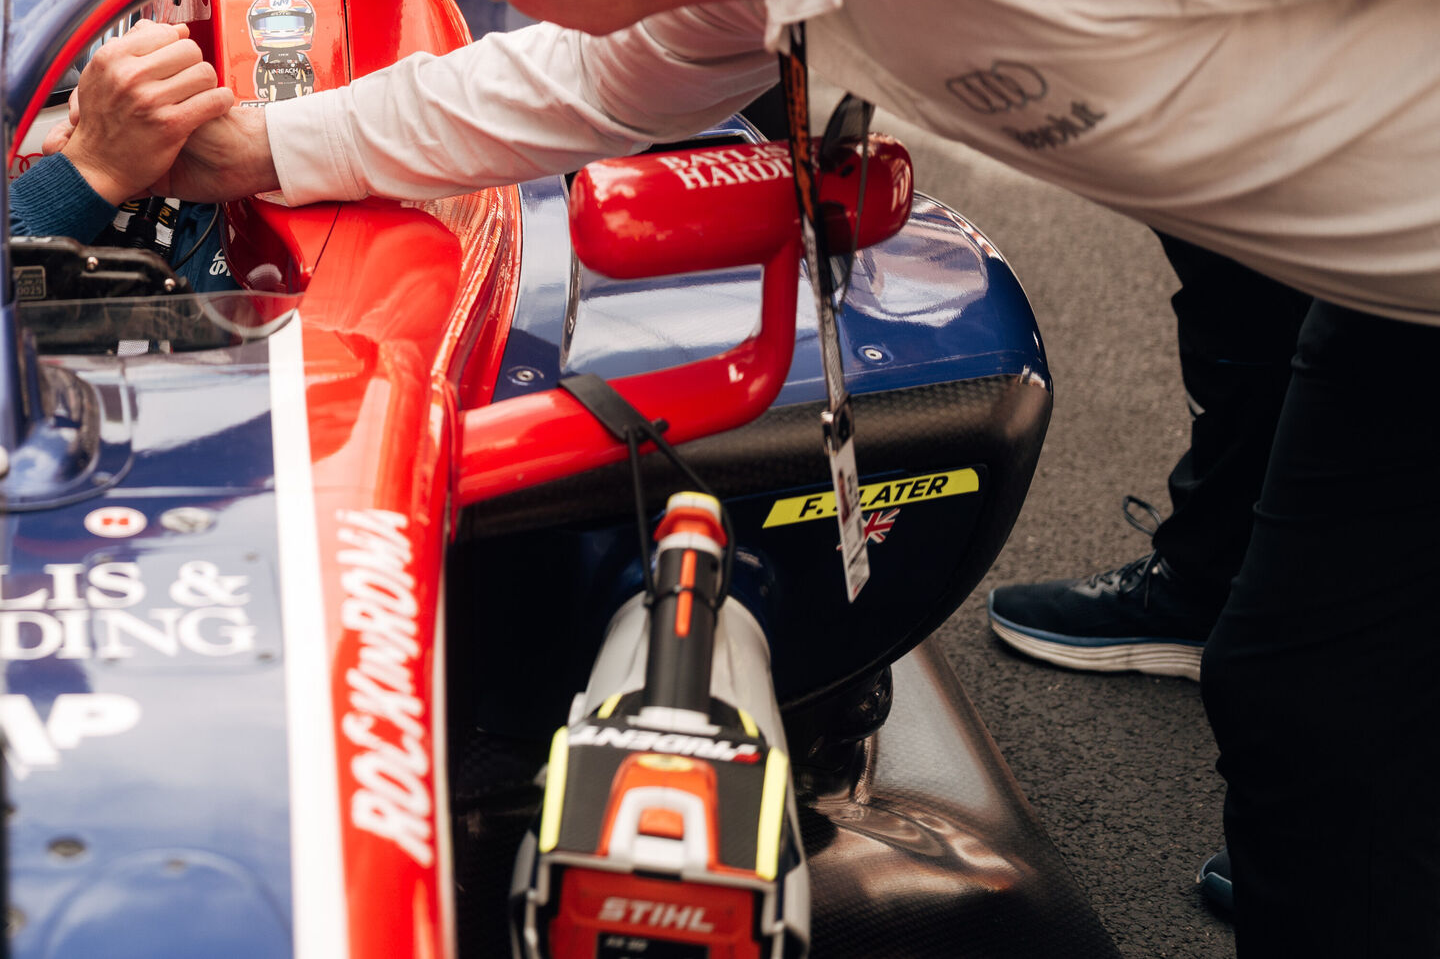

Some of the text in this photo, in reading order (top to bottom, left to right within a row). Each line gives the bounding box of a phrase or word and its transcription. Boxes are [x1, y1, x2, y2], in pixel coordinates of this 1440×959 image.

[799, 495, 824, 518] F.
[169, 559, 252, 607] &
[598, 895, 714, 933] STIHL
